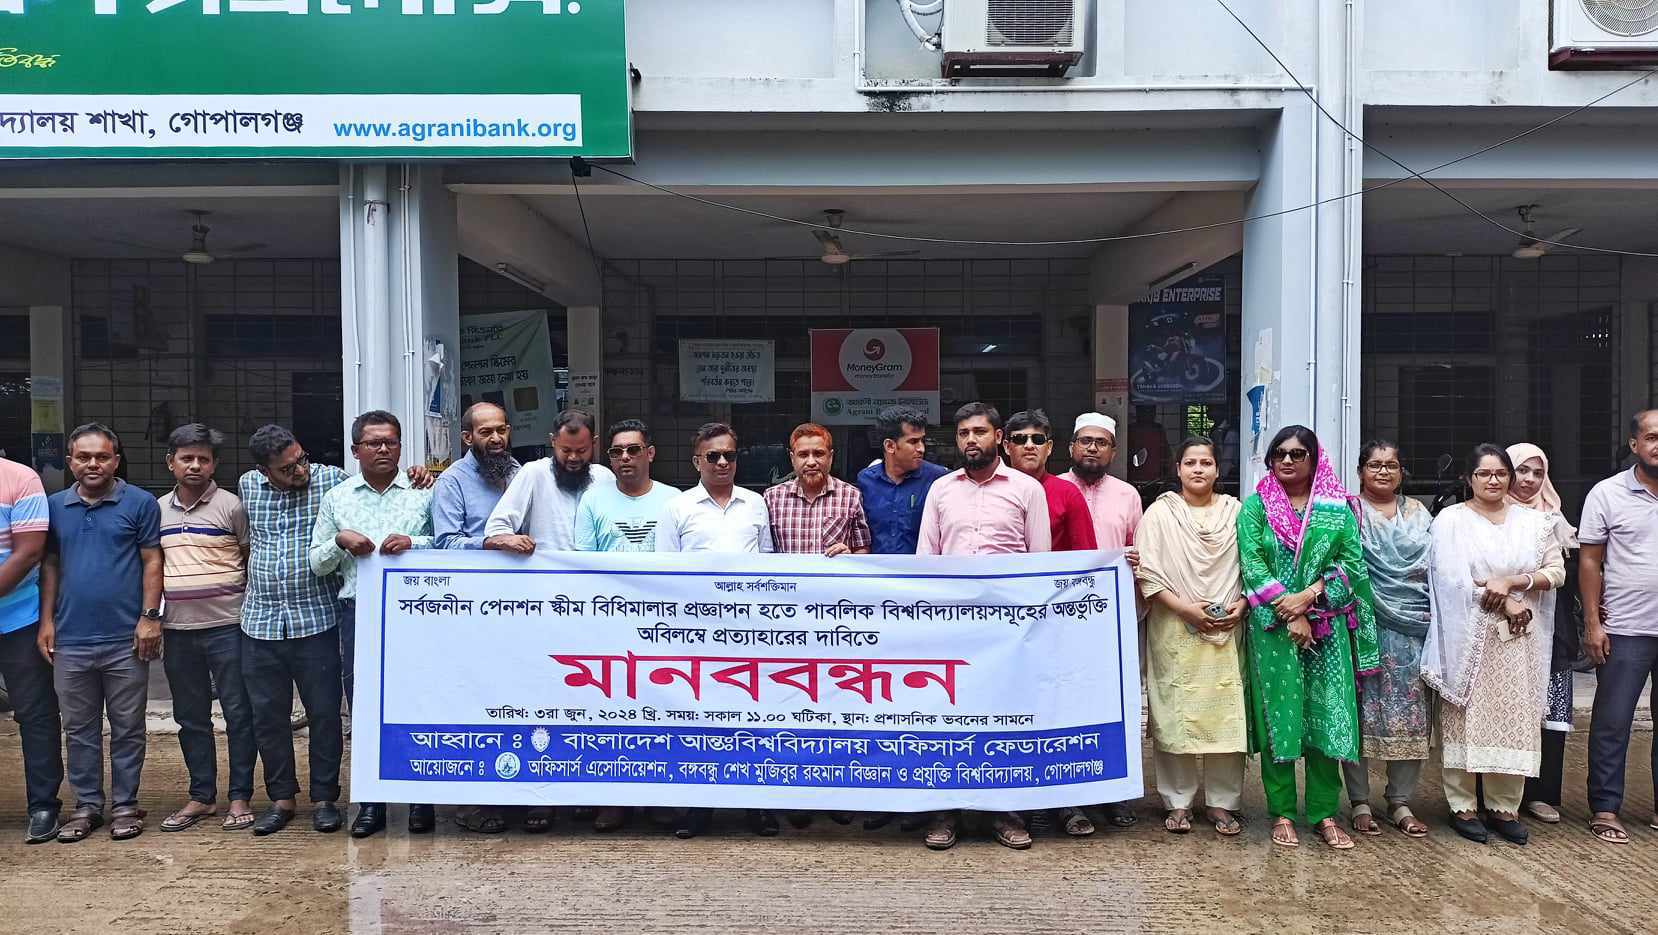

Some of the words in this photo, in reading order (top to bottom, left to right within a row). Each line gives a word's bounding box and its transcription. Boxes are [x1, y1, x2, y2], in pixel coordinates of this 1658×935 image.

[85, 109, 156, 138] শাখা,
[169, 109, 303, 134] গোপালগঞ্জ
[333, 118, 576, 141] www.agranibank.org
[1162, 287, 1222, 302] ENTERPRISE
[847, 363, 903, 373] MoneyGram
[403, 575, 419, 587] জয়
[424, 575, 450, 587] বাংলা
[714, 580, 743, 592] আল্লাহ
[747, 579, 797, 592] সর্বশক্তিমান
[1054, 578, 1068, 589] জয়
[398, 594, 474, 615] সর্বজনীন
[480, 599, 544, 616] পেনশন
[548, 595, 586, 617] স্কীম
[591, 595, 678, 617] বিধিমালার
[684, 601, 751, 619] প্রজ্ঞাপন
[757, 603, 798, 620] হতে
[805, 599, 875, 620] পাবলিক
[881, 600, 1048, 626] বিশ্ববিদ্যালয়সমূহের
[1052, 594, 1108, 621] অন্তর্ভুক্তি
[637, 623, 707, 644] অবিলম্বে
[713, 628, 808, 646] প্রত্যাহারের
[815, 625, 880, 647] দাবিতে
[547, 650, 971, 705] মানববন্ধন
[485, 705, 528, 719] তারিখ:
[534, 708, 559, 719] ৩রা
[599, 709, 637, 721] ২০২৪
[641, 706, 661, 722] খ্রি.
[666, 710, 699, 721] সময়:
[704, 710, 742, 722] সকাল
[747, 711, 786, 723] ১১.০০
[791, 709, 836, 725] ঘটিকা,
[841, 712, 869, 726] স্থান:
[874, 711, 937, 725] প্রশাসনিক
[943, 714, 989, 726] ভবনের
[993, 714, 1034, 725] সামনে
[560, 732, 674, 751] বাংলাদেশ
[679, 730, 870, 755] আন্তঃবিশ্ববিদ্যালয়
[875, 734, 976, 756] অফিসার্স
[984, 733, 1101, 756] ফেডারেশন
[410, 758, 474, 776] আয়োজনে
[528, 755, 583, 777] অফিসার্স
[678, 761, 719, 783] বঙ্গবন্ধু
[724, 761, 750, 778] শেখ
[754, 758, 799, 784] মুজিবুর
[802, 764, 845, 782] রহমান
[849, 760, 892, 783] বিজ্ঞান
[897, 767, 907, 782] ও
[912, 762, 952, 787] প্রযুক্তি
[1045, 759, 1104, 780] গোপালগঞ্জ
